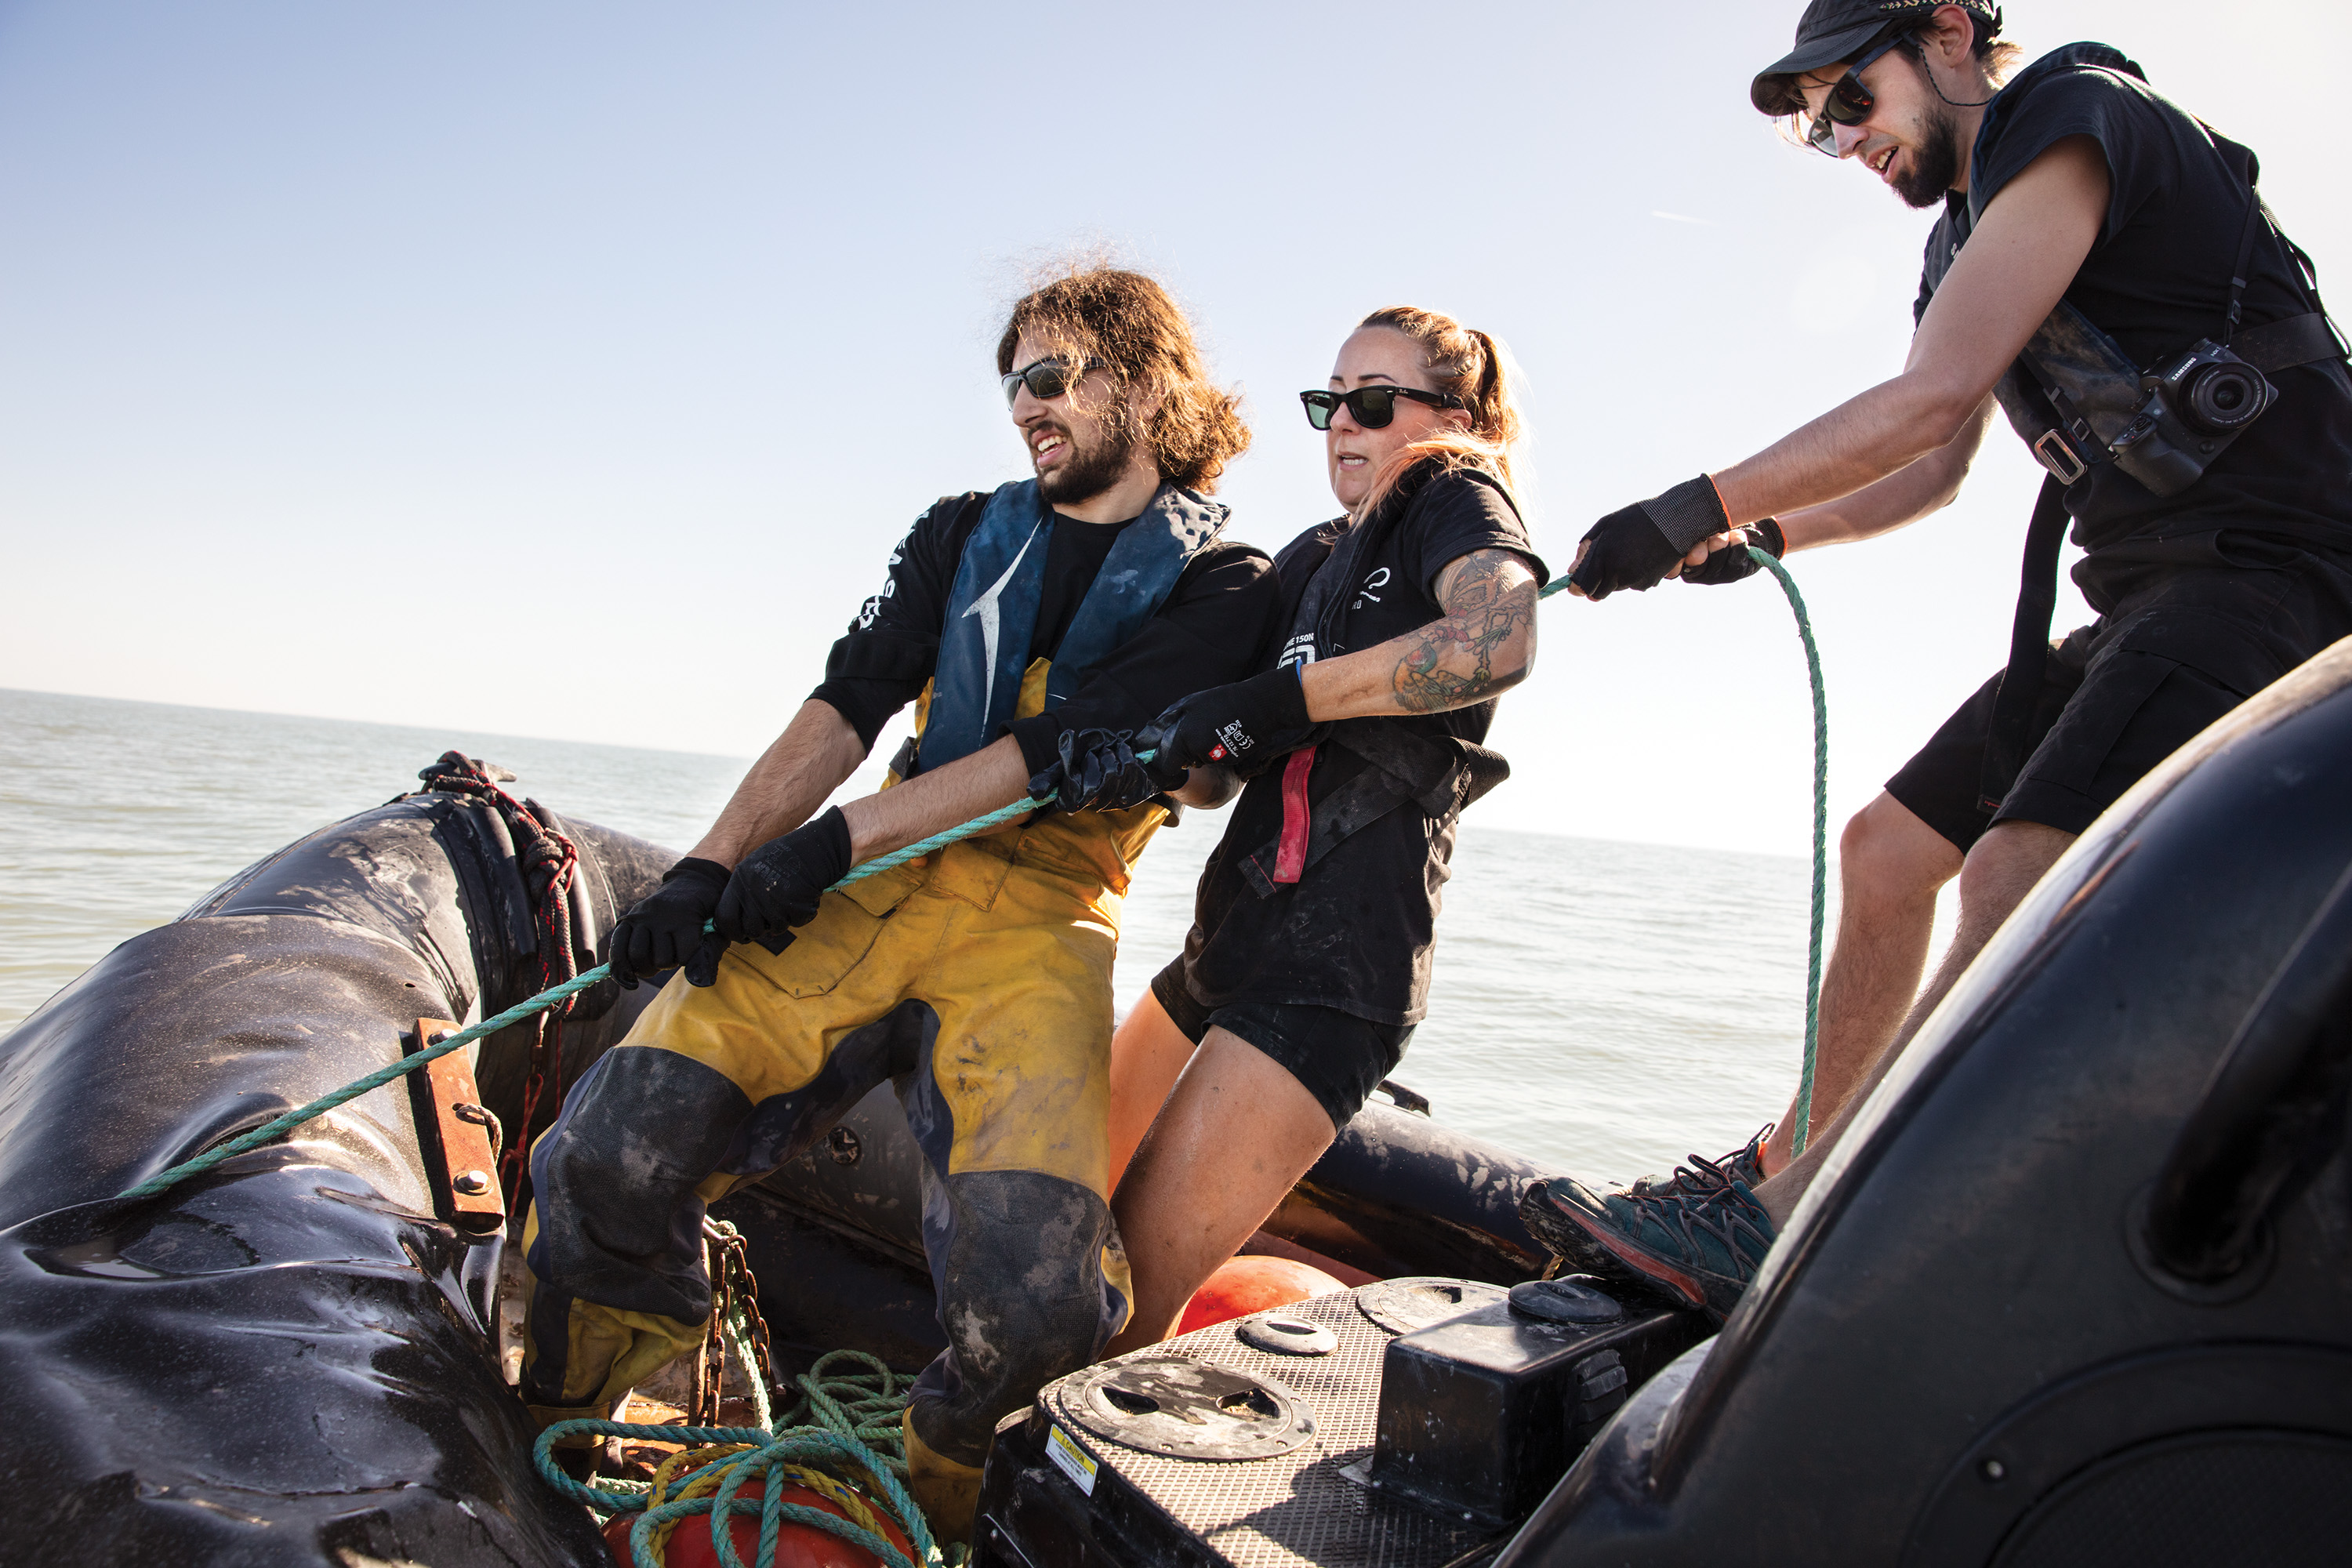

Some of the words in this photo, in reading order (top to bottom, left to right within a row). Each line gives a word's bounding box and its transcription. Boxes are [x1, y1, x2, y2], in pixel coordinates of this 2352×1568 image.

[2171, 357, 2197, 381] SAMSUNG
[1295, 632, 1315, 644] 150N
[1065, 1441, 1085, 1464] CAUTION
